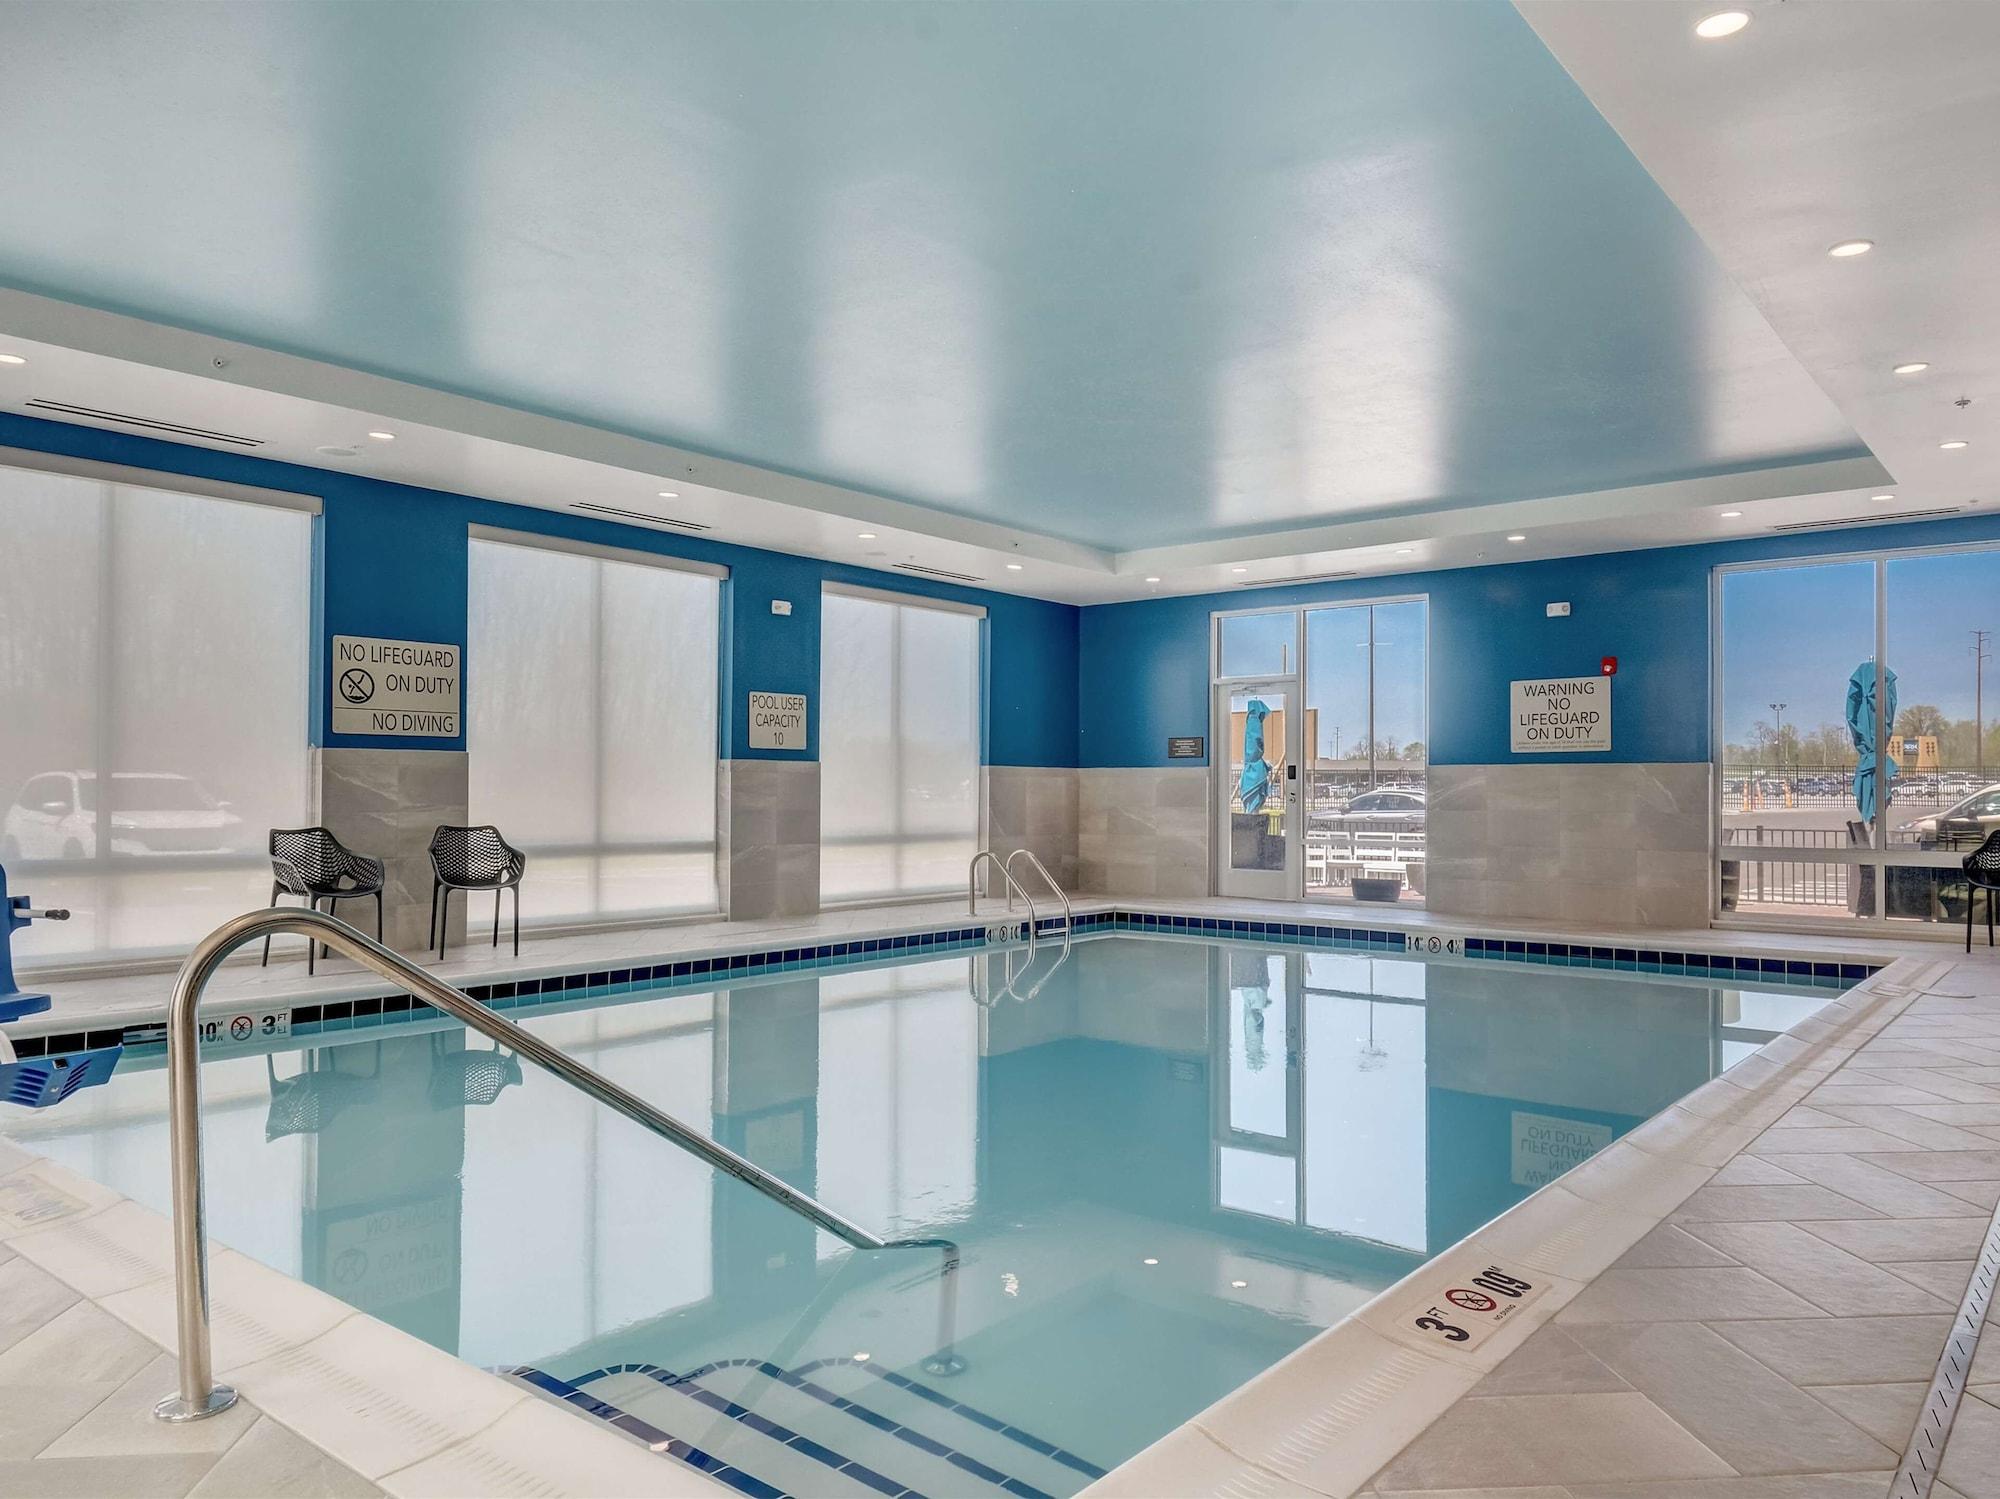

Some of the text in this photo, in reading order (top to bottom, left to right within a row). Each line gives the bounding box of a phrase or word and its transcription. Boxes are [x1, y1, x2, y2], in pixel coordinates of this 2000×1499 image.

[340, 642, 454, 668] NO LIFEGUARD
[386, 673, 454, 694] ON DUTY
[1524, 681, 1595, 697] WARNING
[752, 694, 804, 711] POOL USER
[1548, 697, 1571, 711] NO
[372, 713, 454, 733] NO DIVING
[755, 713, 801, 728] CAPACITY
[1520, 711, 1600, 726] LIFEGUARD
[774, 731, 784, 745] 10
[1527, 726, 1593, 740] ON DUTY
[1416, 1306, 1470, 1342] 3 FT
